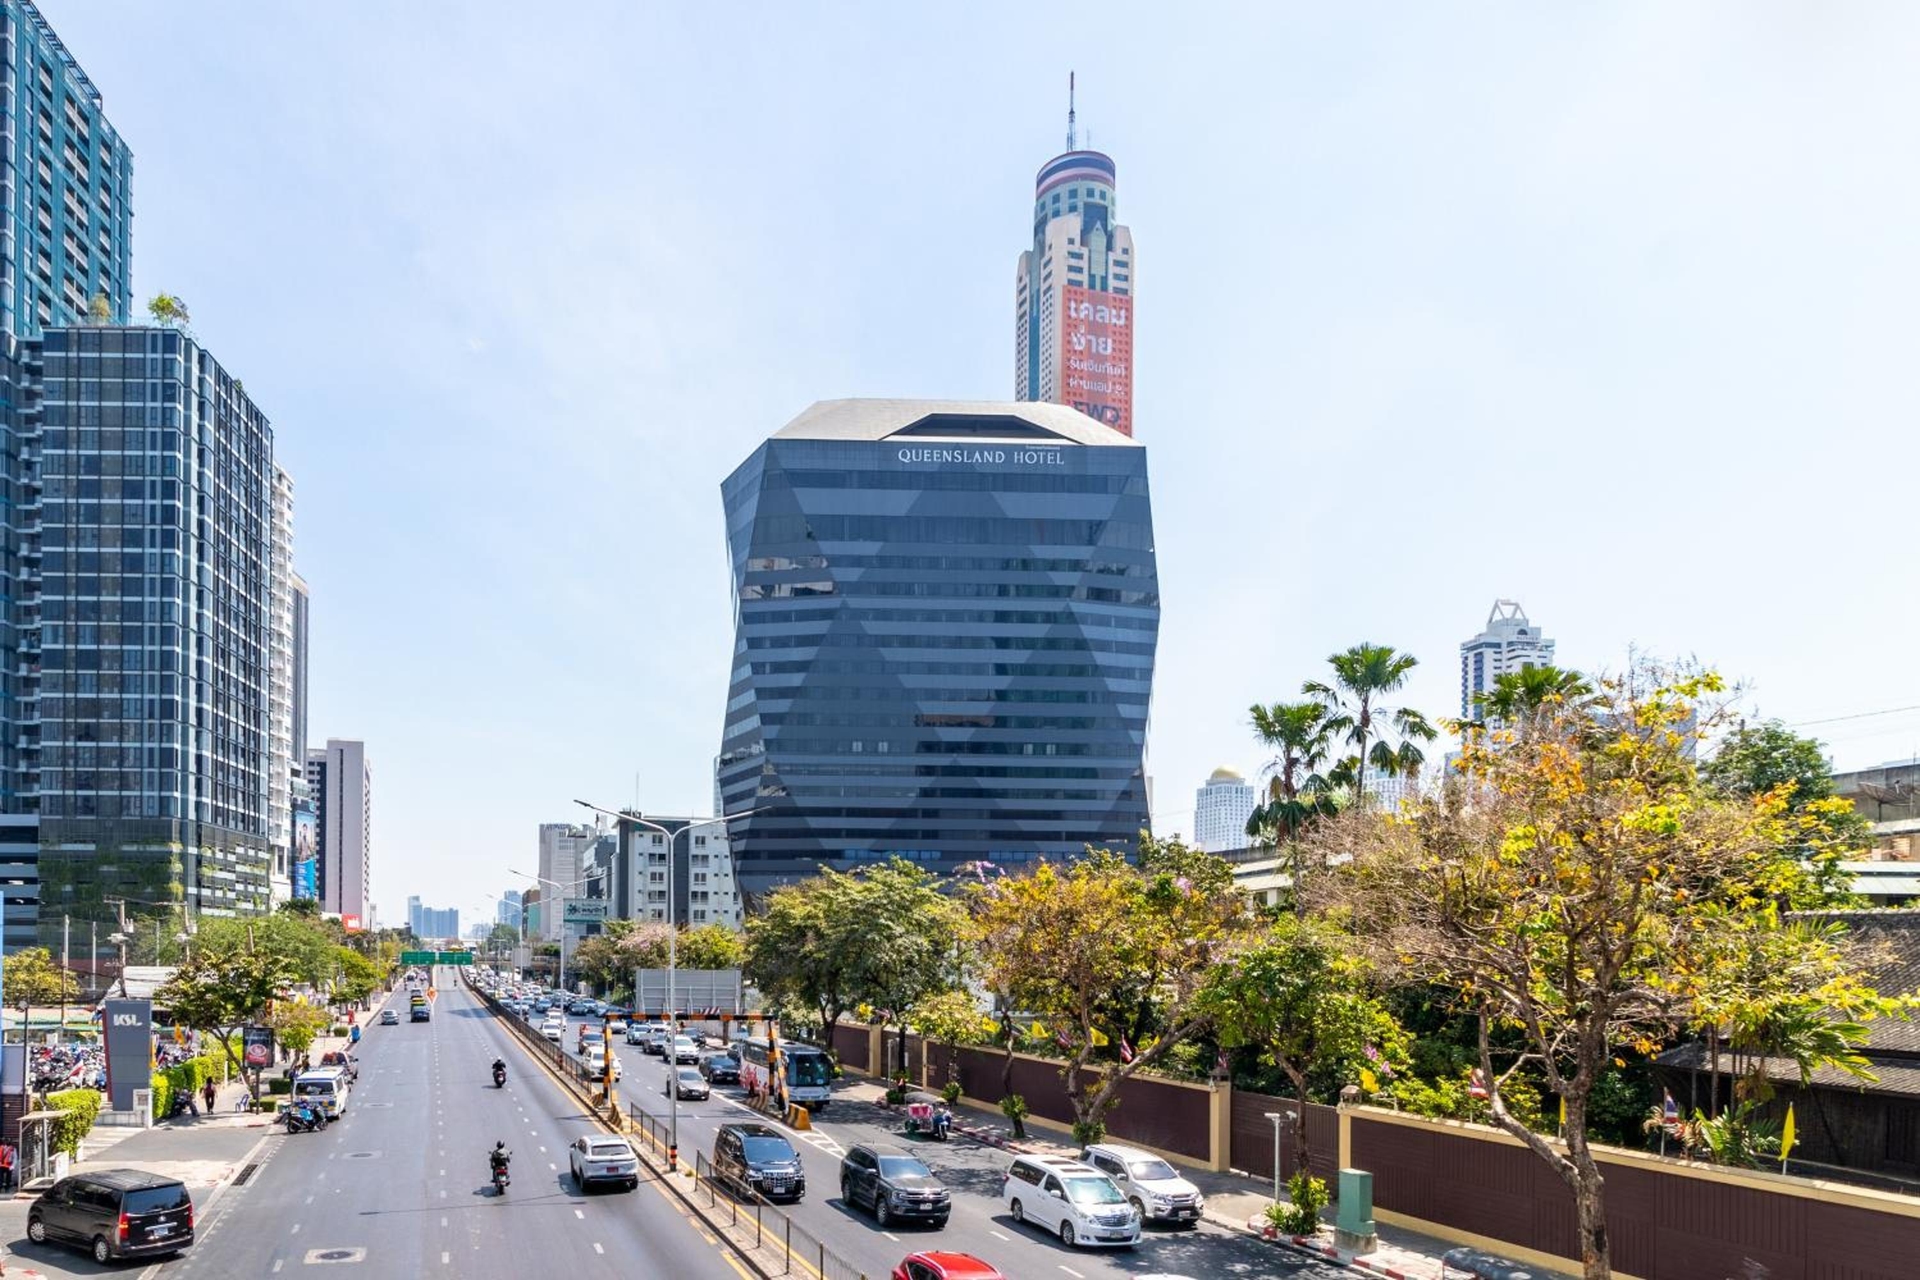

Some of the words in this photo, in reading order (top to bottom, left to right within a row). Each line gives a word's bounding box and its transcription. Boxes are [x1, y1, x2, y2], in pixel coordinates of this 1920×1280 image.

[1070, 299, 1126, 327] เคลม
[898, 448, 1005, 463] QUEENSLAND
[1014, 451, 1065, 465] HOTEL
